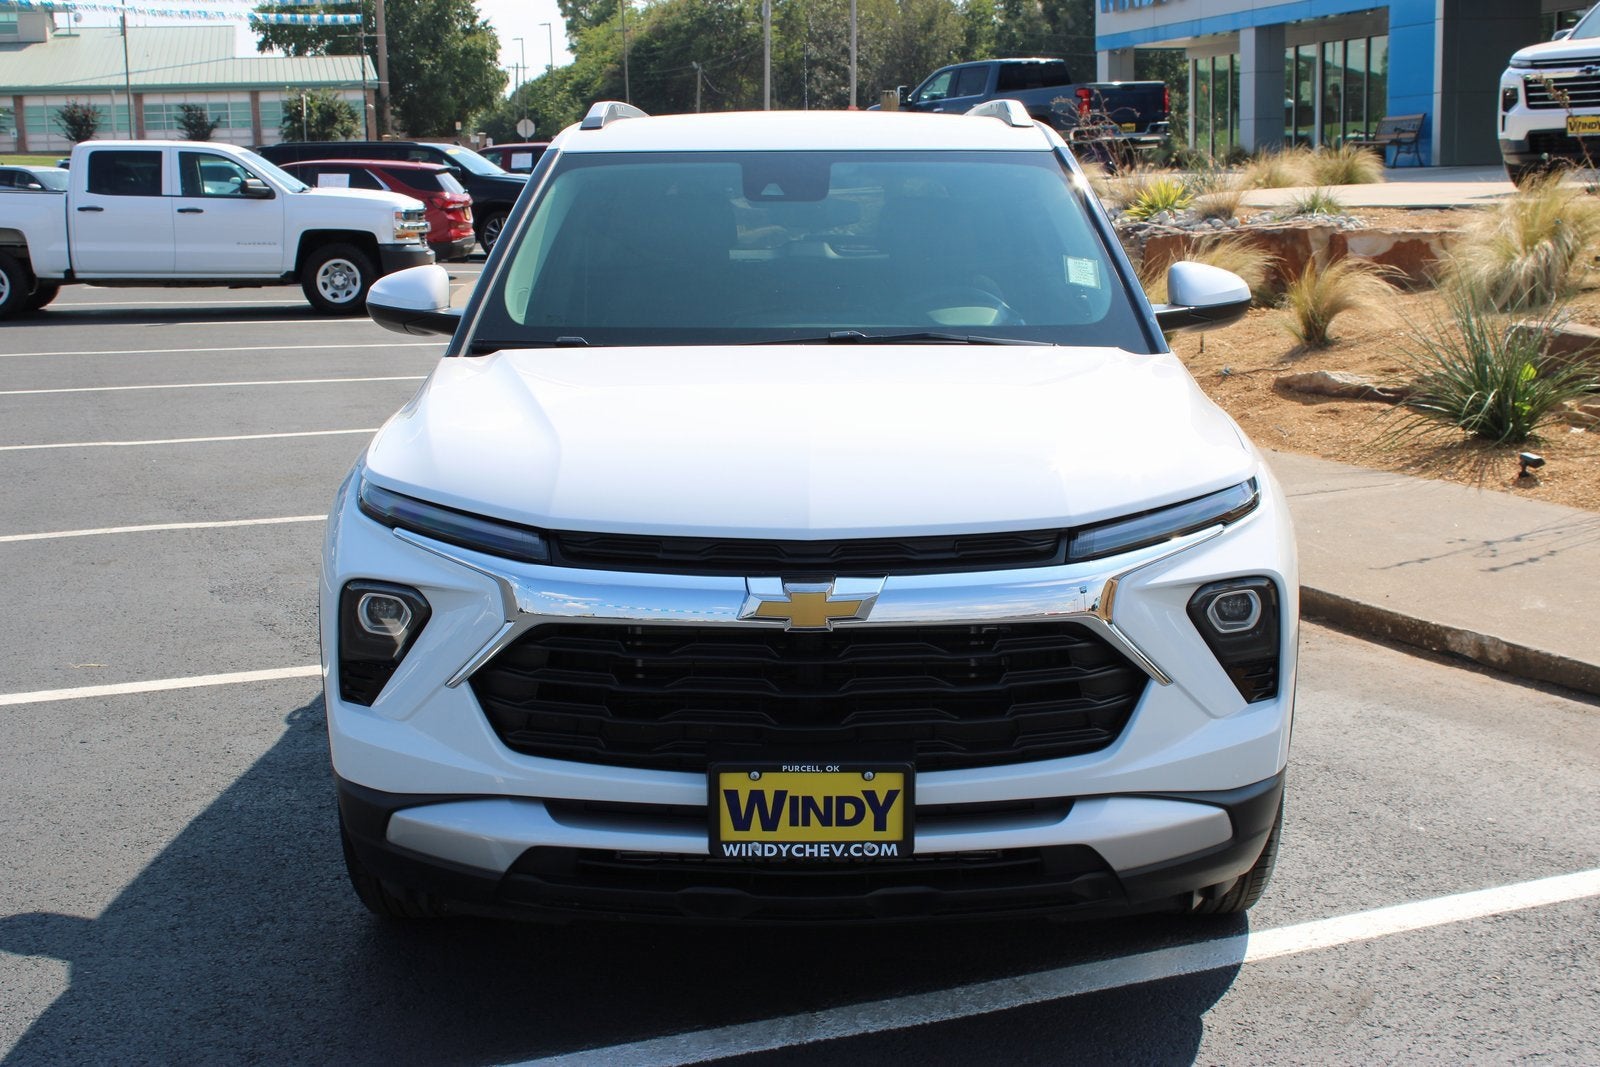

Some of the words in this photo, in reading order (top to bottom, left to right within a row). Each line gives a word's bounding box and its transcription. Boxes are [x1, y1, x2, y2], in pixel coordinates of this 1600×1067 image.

[782, 765, 823, 773] PURCELL,
[826, 765, 840, 773] OK
[723, 789, 901, 832] WINDY
[723, 843, 898, 857] WINDYCHEV.COM
